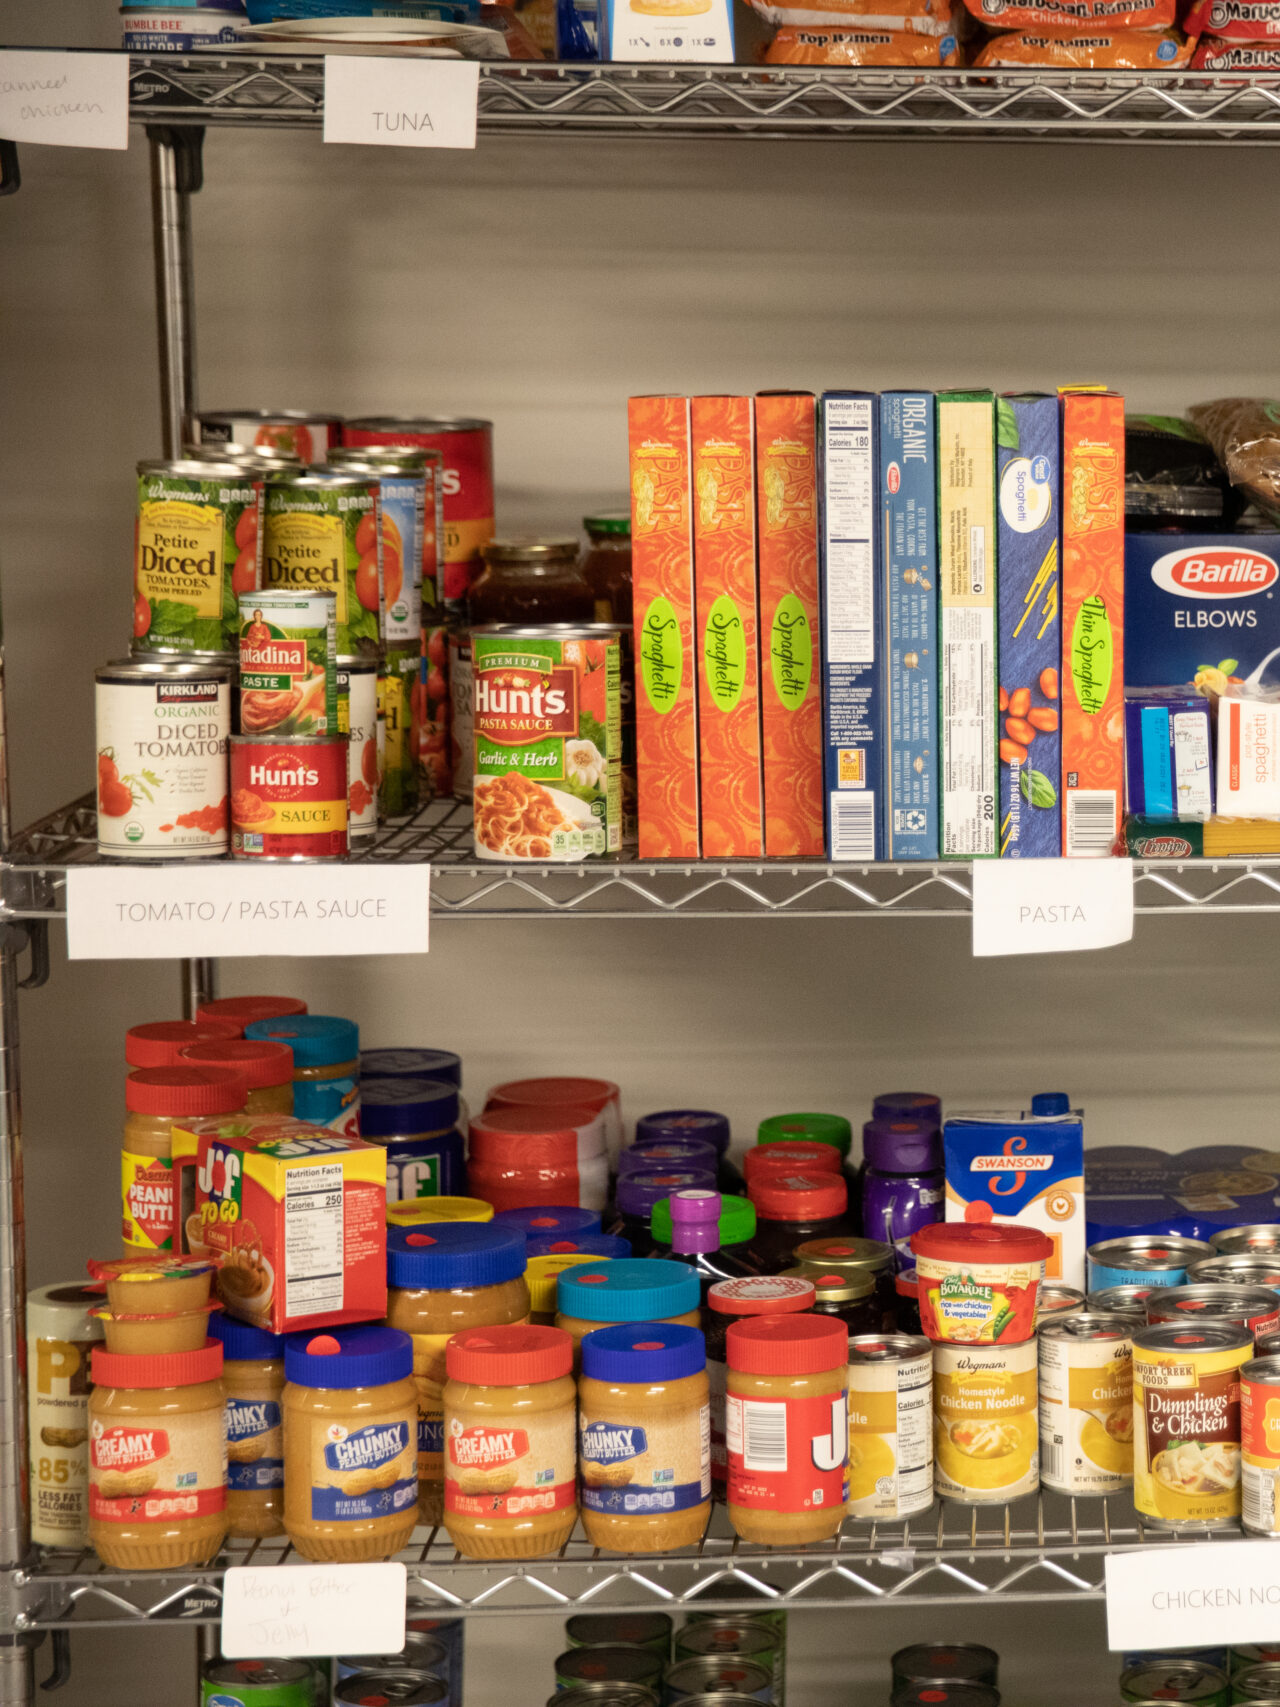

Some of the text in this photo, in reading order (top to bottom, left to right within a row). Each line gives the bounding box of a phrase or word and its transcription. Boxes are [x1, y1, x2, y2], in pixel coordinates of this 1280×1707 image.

[160, 20, 183, 31] BEE
[798, 32, 828, 46] Top
[133, 83, 171, 94] METRO
[371, 111, 434, 133] TUNA
[853, 402, 868, 411] Facts
[902, 397, 927, 464] ORGANIC
[828, 436, 869, 447] Calories 180
[148, 482, 210, 503] Wegmans
[1016, 471, 1027, 522] Spaghetti
[154, 533, 198, 550] Petite
[278, 544, 321, 559] Petite
[141, 545, 216, 577] Diced
[267, 558, 341, 585] Diced
[1181, 559, 1270, 584] Barilla
[1174, 609, 1258, 629] ELBOWS
[484, 656, 541, 669] PREMIUM
[642, 614, 677, 700] Spaghetti
[705, 612, 740, 699] Spaghetti
[771, 611, 806, 697] Spaghetti
[243, 676, 279, 688] PASTE
[1073, 636, 1105, 714] Spaghetti
[159, 684, 217, 697] KIRKLAND
[154, 704, 220, 719] ORGANIC
[157, 723, 219, 741] DICED
[479, 718, 554, 731] PASTA SAUCE
[479, 750, 558, 767] Garlic & Herb
[1010, 757, 1020, 770] NET
[281, 809, 331, 823] SAUCE
[983, 794, 994, 821] 200
[115, 899, 387, 923] TOMATO / PASTA SAUCE
[1019, 904, 1087, 924] PASTA
[286, 1164, 342, 1180] Nutrition Facts
[976, 1156, 1047, 1171] SWANSON
[286, 1194, 341, 1212] Calories 250
[940, 1281, 992, 1300] BOYARDEE
[940, 1299, 993, 1312] rice chicken
[951, 1308, 987, 1322] vegetables
[956, 1356, 1007, 1375] Wegmans
[1160, 1366, 1193, 1377] CREEK
[1142, 1375, 1169, 1386] FOODS
[958, 1386, 1006, 1400] Homestyle
[36, 1397, 79, 1409] powdered
[939, 1394, 1026, 1411] Chicken Noodle
[1148, 1391, 1229, 1421] Dumplings
[1151, 1413, 1229, 1438] & Chicken
[94, 1432, 155, 1459] CREAMY
[334, 1425, 403, 1463] CHUNKY
[454, 1432, 514, 1456] CREAMY
[581, 1428, 634, 1450] CHUNKY
[37, 1491, 83, 1504] LESS FAT
[37, 1501, 82, 1514] CALORIES
[184, 1598, 218, 1609] METRO
[1152, 1587, 1241, 1611] CHICKEN
